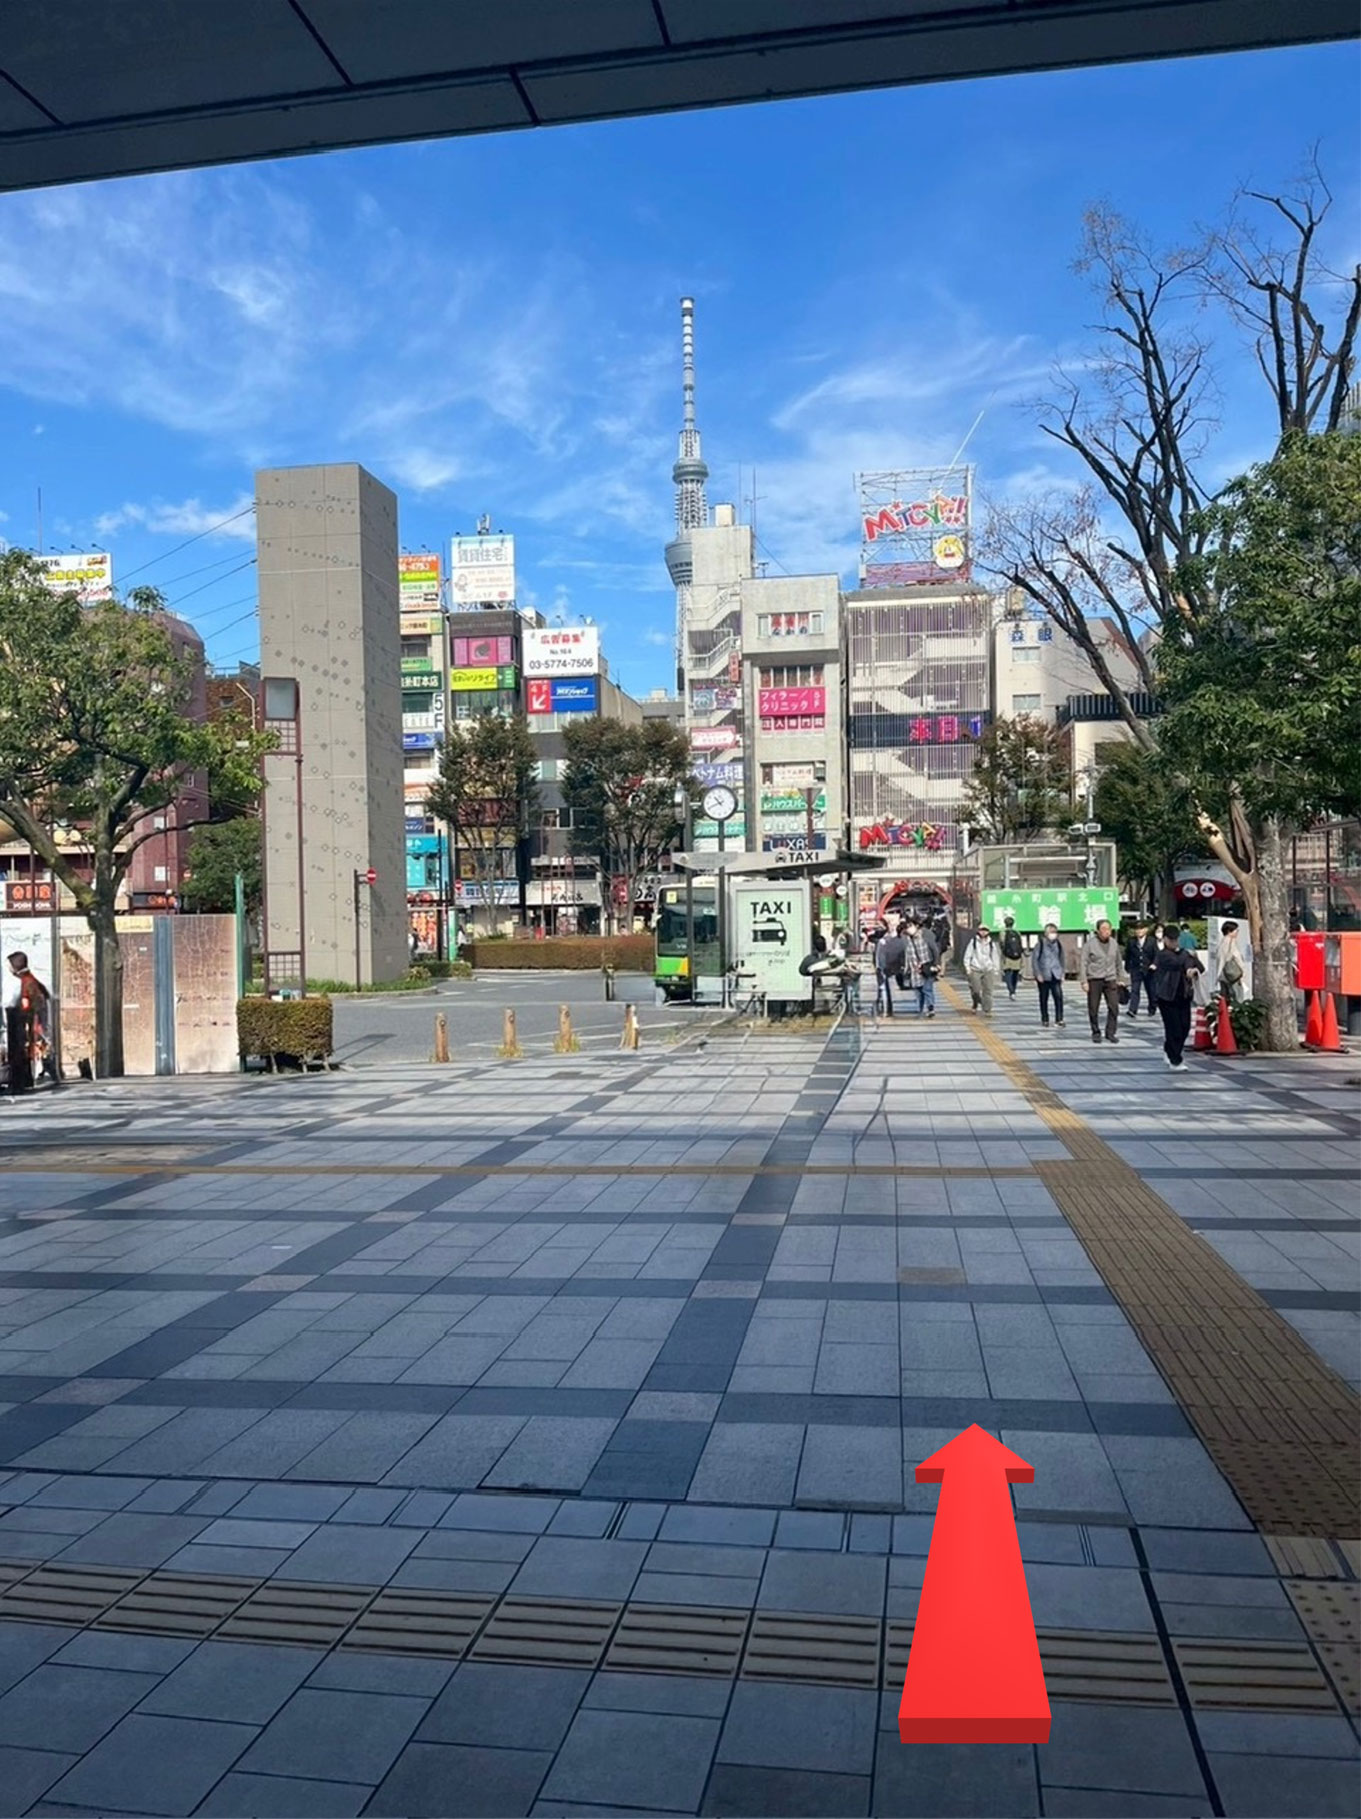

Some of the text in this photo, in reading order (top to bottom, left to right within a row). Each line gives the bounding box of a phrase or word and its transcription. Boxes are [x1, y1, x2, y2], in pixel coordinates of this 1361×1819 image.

[529, 658, 594, 670] 03-5774-7506
[761, 700, 809, 712] クリニック
[788, 852, 819, 862] TAXI
[750, 901, 791, 914] TAXI
